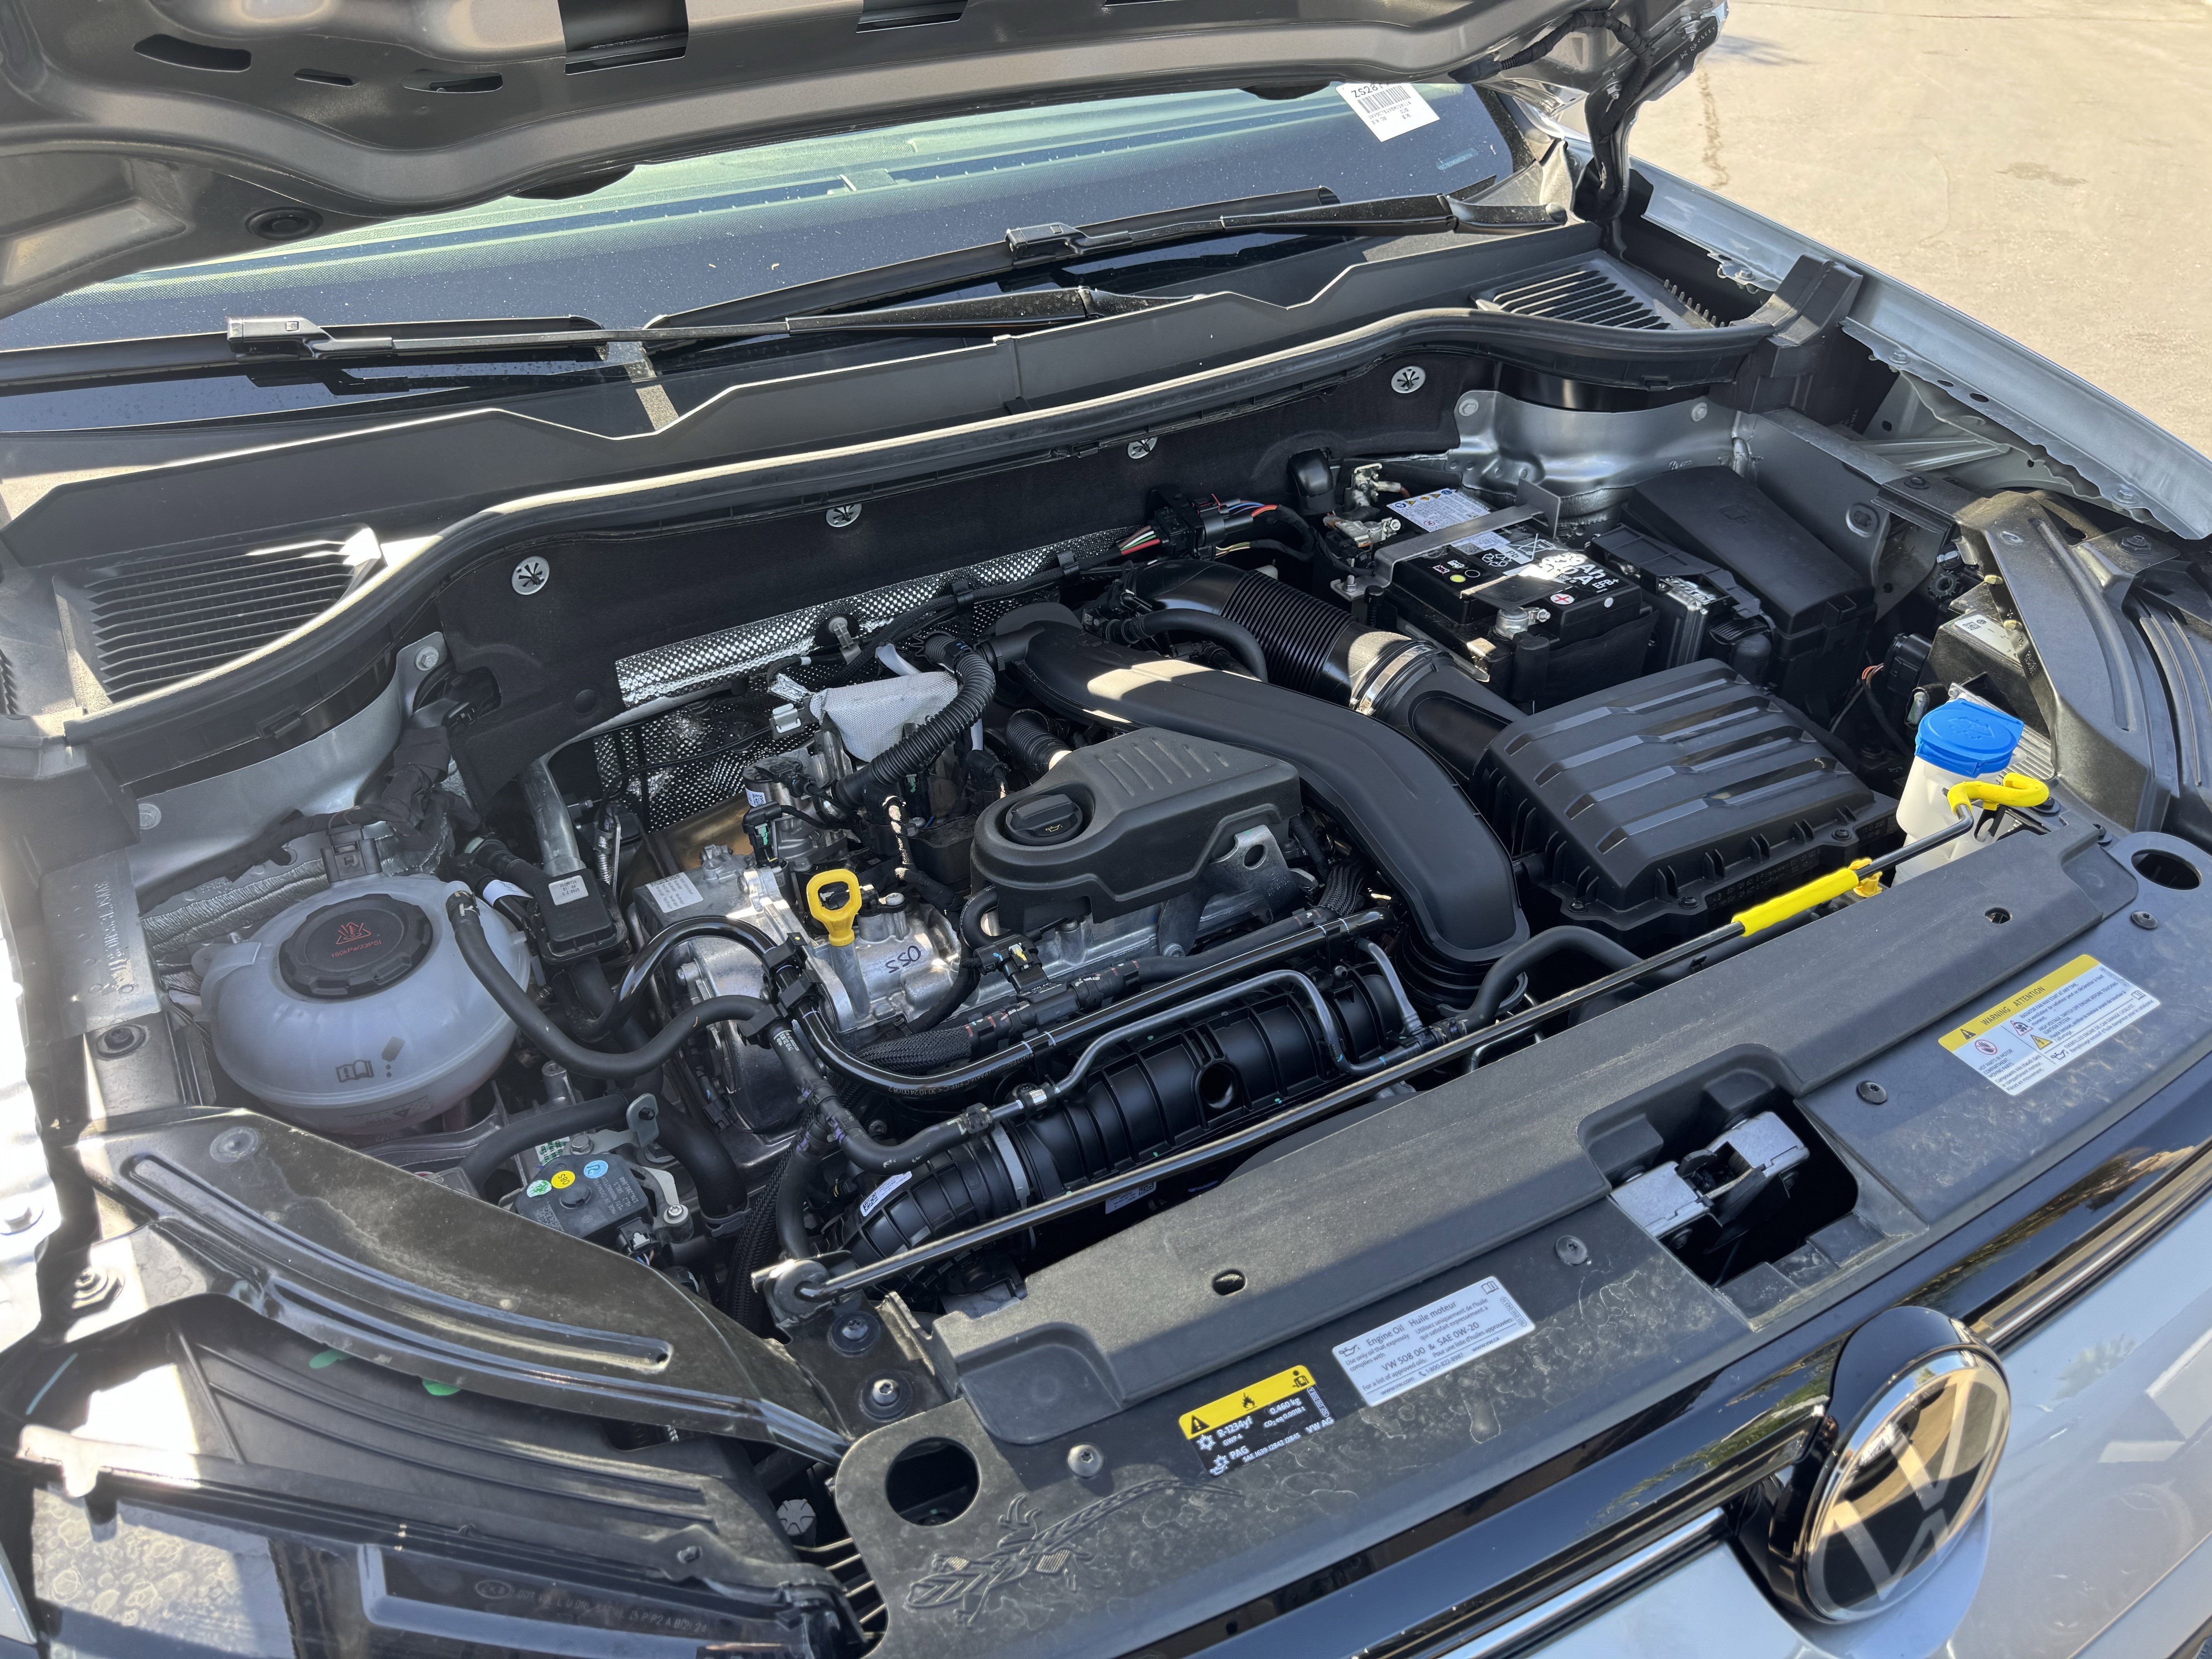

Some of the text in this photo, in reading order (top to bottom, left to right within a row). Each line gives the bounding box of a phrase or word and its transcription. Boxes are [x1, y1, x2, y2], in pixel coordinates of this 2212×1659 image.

[1592, 579, 1620, 589] EFB+
[1980, 986, 2046, 1025] WARNING ATTENTION
[2019, 1007, 2037, 1018] RADIATOR
[2030, 1008, 2049, 1020] ventilateur
[2051, 996, 2067, 1007] radiateur
[1985, 1058, 1997, 1066] PARTS
[1999, 1048, 2013, 1058] MOTOR
[1408, 1301, 1456, 1326] Huile moteur
[1414, 1322, 1435, 1334] Utilisez
[1434, 1308, 1466, 1326] uniquement
[1471, 1298, 1488, 1307] l'huile
[1419, 1333, 1429, 1341] qui
[1429, 1323, 1449, 1336] satisfait
[1449, 1307, 1485, 1326] expressément
[1365, 1324, 1405, 1346] Engine Oil
[1381, 1359, 1397, 1371] VW
[1397, 1352, 1414, 1364] 508
[1413, 1346, 1425, 1357] 00
[1436, 1333, 1453, 1345] SAE
[1452, 1321, 1479, 1338] 0W-20
[1432, 1349, 1445, 1357] Pour
[1465, 1330, 1485, 1342] d'huiles
[1355, 1352, 1368, 1361] only
[1374, 1344, 1386, 1352] that
[1386, 1333, 1410, 1347] expressly
[1349, 1352, 1386, 1372] complies with
[1380, 1336, 1500, 1395] www.vw.com 1-800-822-8987 www.vw.ca
[1391, 1362, 1417, 1377] approved
[1269, 1397, 1302, 1414] 0.460 kg
[1282, 1407, 1302, 1419] 0.0018
[1216, 1415, 1253, 1438] R-1234yf
[1305, 1416, 1334, 1433] VW AG
[1223, 1435, 1237, 1446] GWP
[1242, 1432, 1301, 1462] SAE J639 J2842 J2845
[1229, 1445, 1249, 1459] PAG
